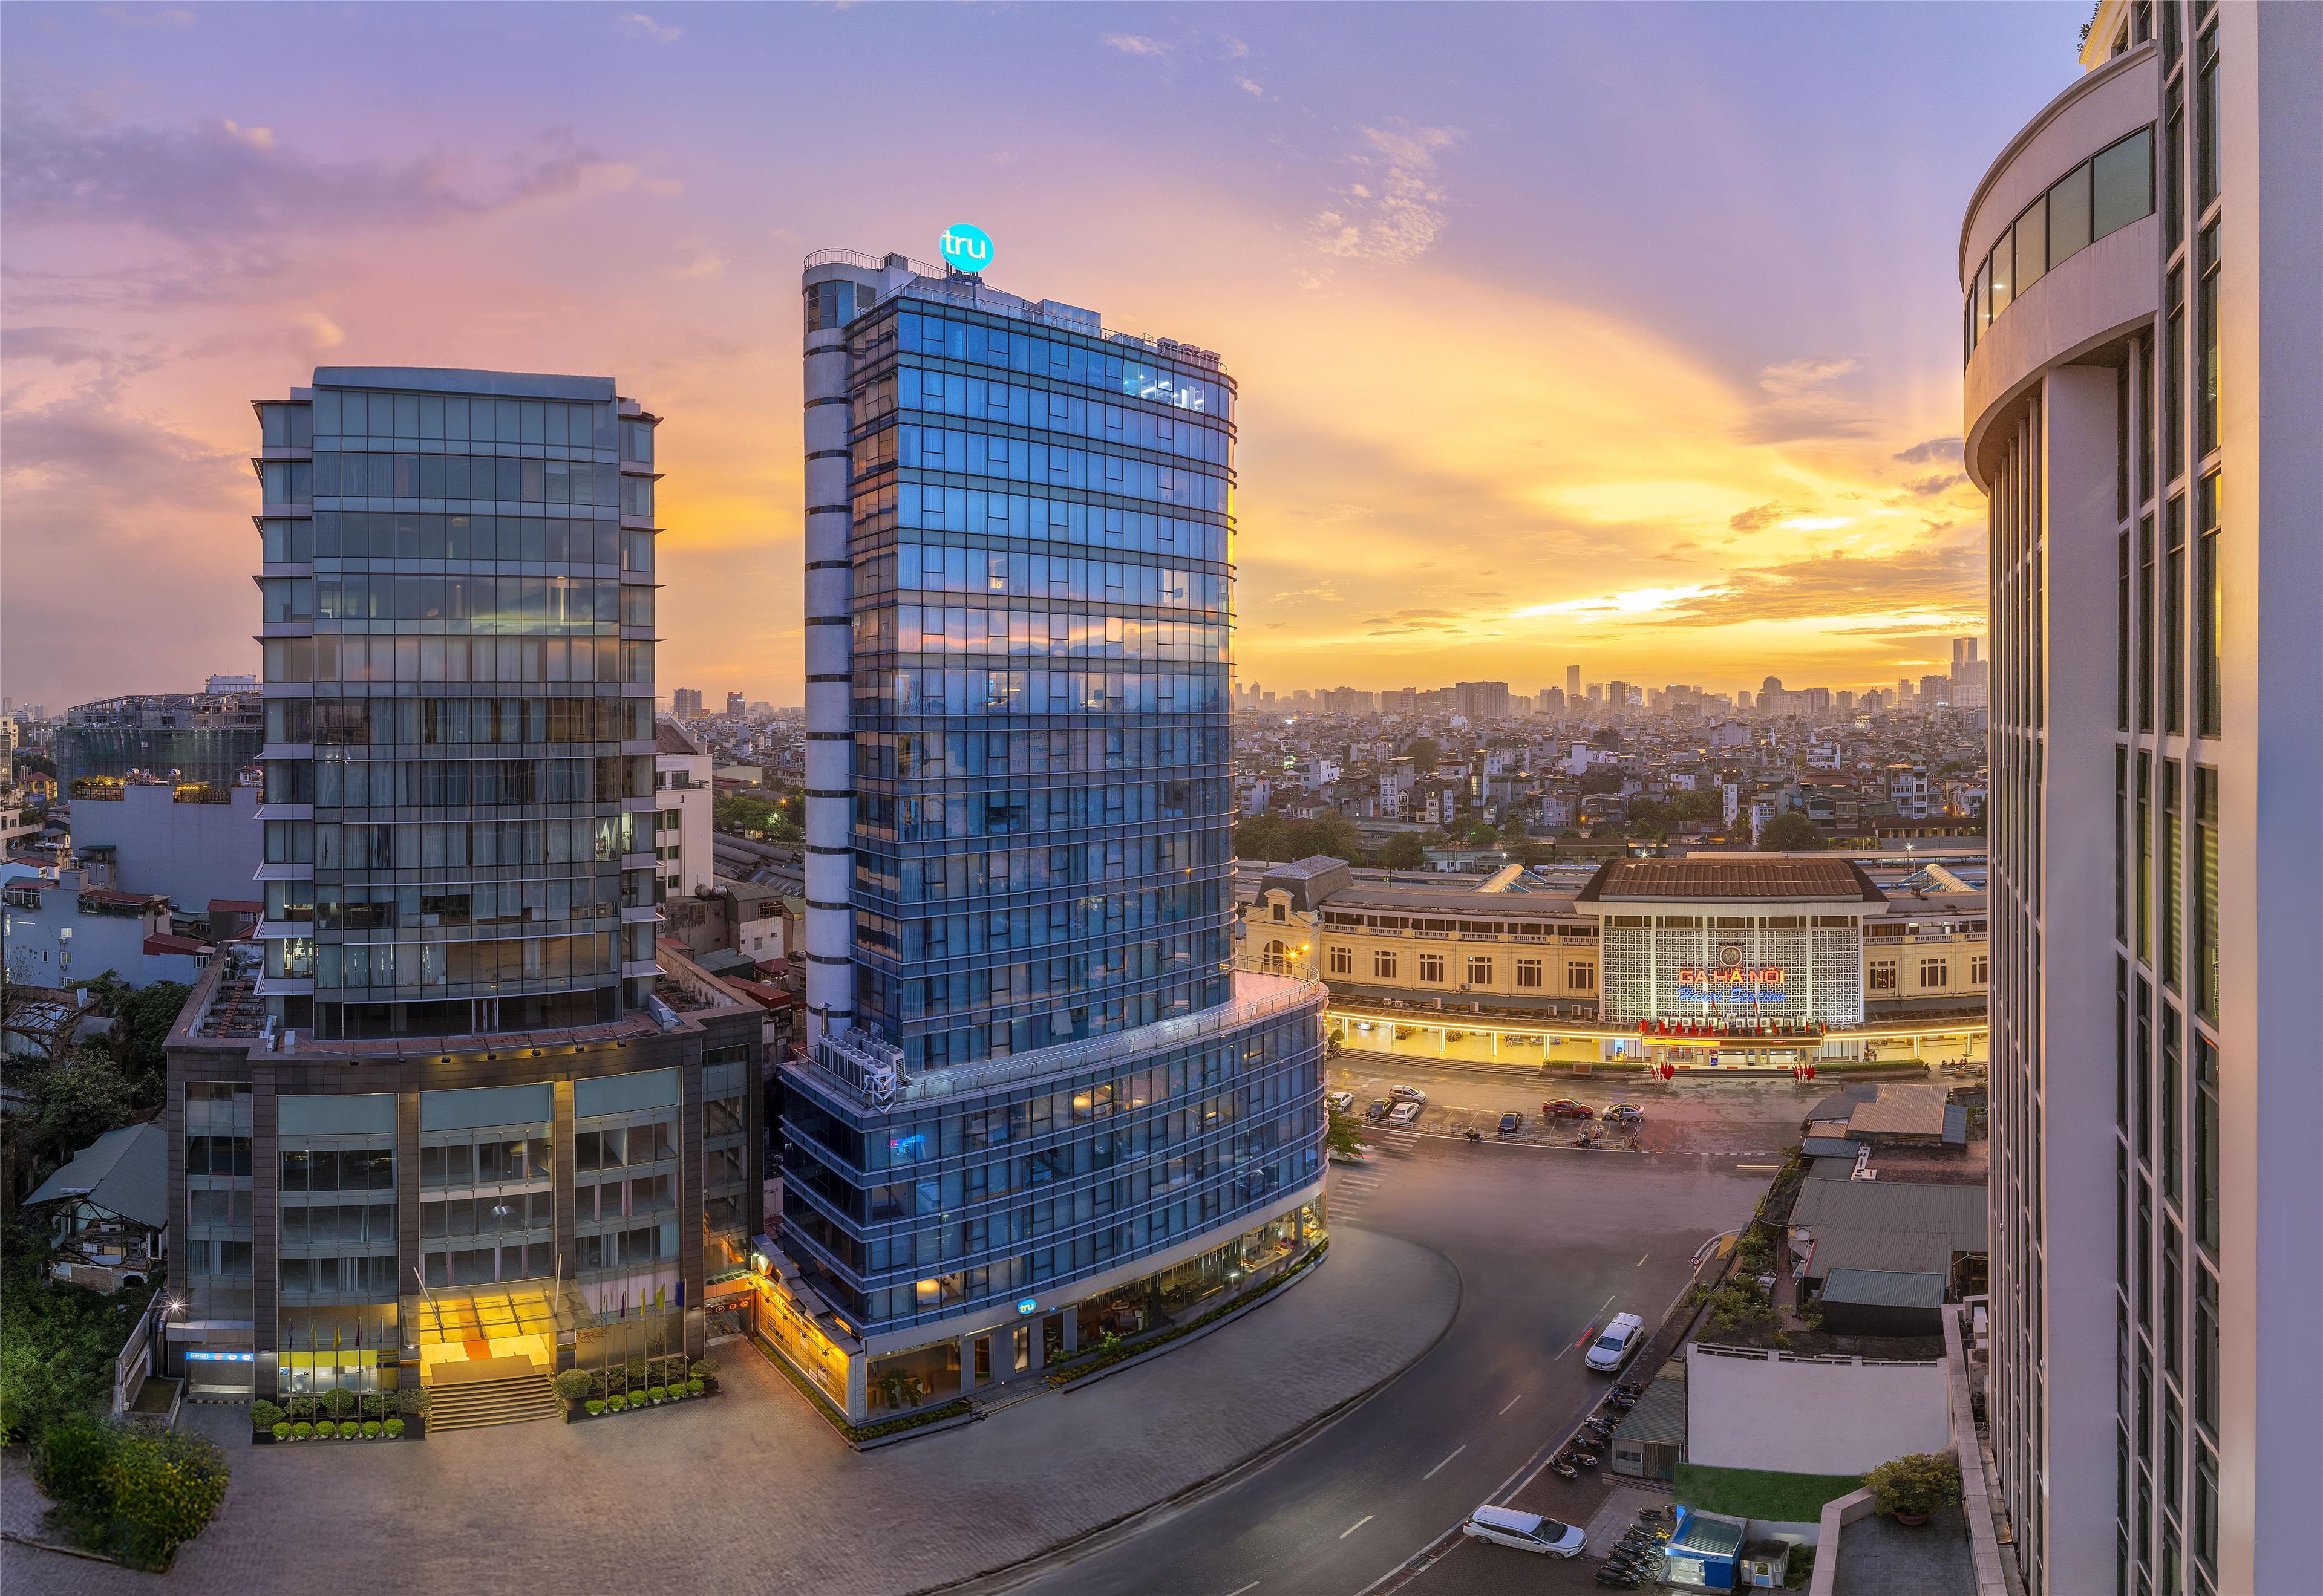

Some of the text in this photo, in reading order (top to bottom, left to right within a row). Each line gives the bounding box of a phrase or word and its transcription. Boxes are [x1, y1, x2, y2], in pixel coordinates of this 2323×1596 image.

[942, 230, 986, 259] tru
[1679, 966, 1785, 985] GA HÀ NỘI
[1678, 987, 1786, 1003] Hanoi Station
[1019, 1303, 1034, 1312] tru
